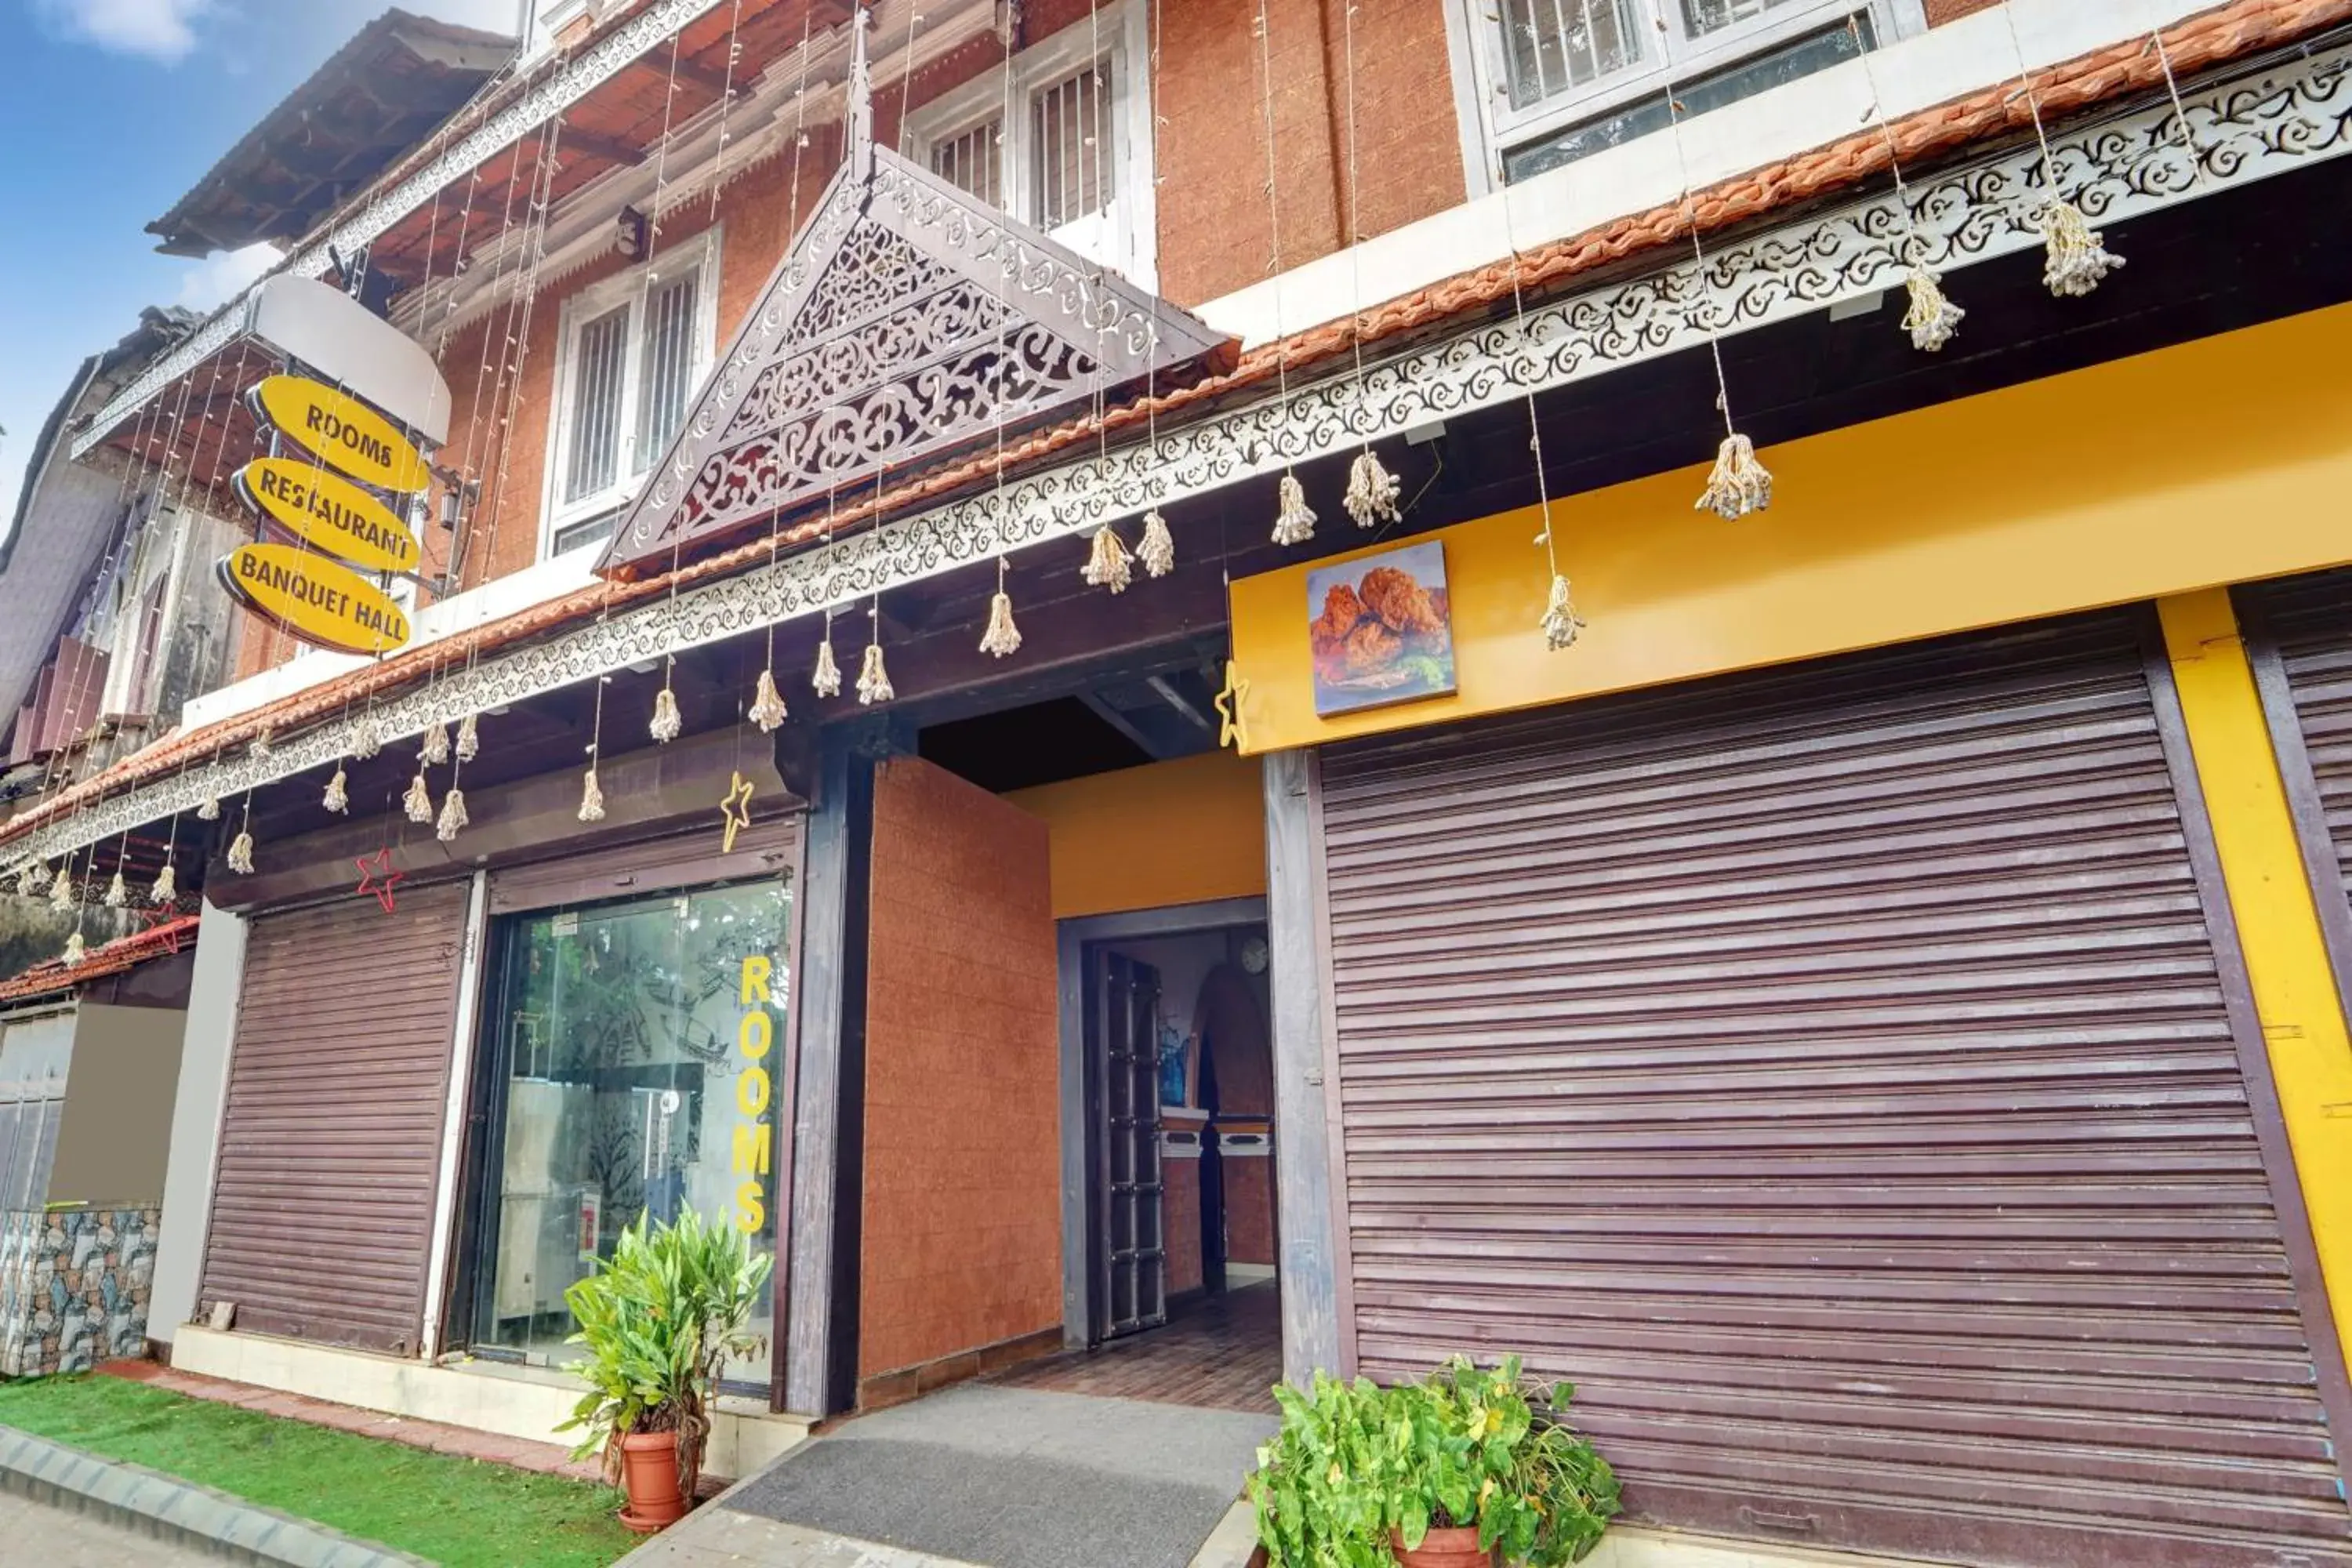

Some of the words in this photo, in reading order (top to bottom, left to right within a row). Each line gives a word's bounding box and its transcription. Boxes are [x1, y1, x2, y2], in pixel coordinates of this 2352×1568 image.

[307, 405, 391, 468] ROOMS
[260, 469, 408, 560] RESTAURANT
[240, 553, 350, 618] BANQUET
[355, 601, 403, 641] HALL
[731, 956, 772, 1233] ROOMS
